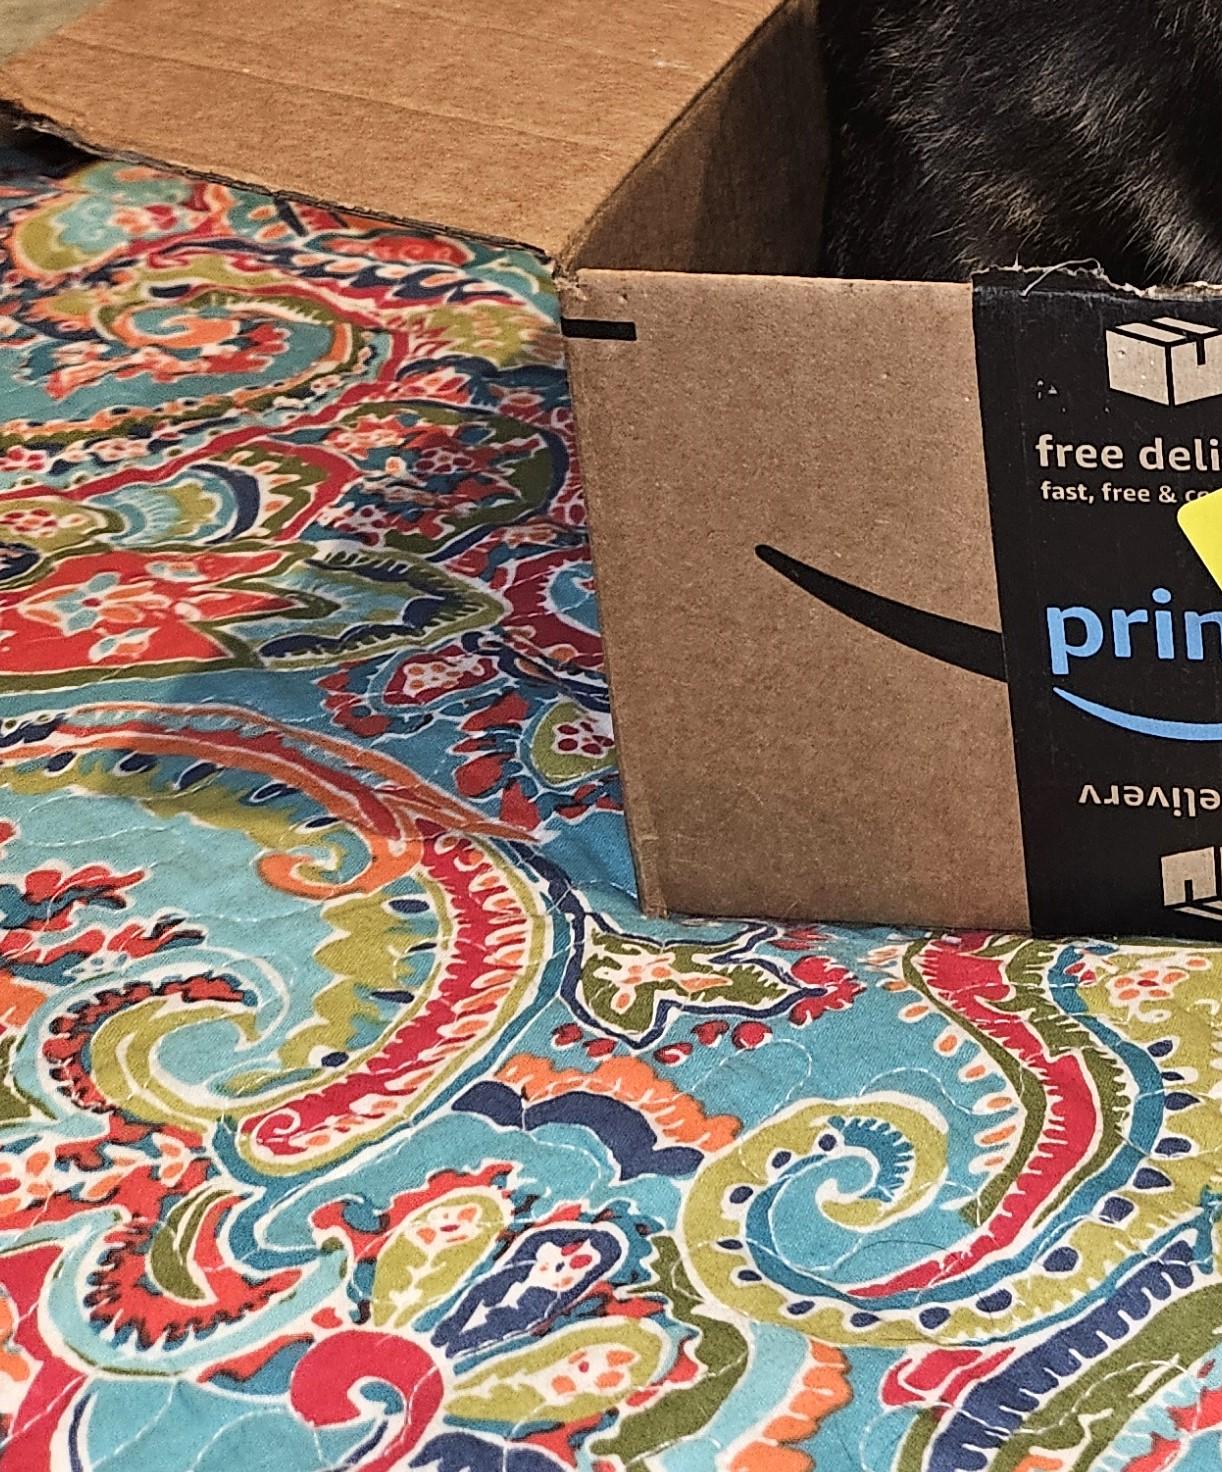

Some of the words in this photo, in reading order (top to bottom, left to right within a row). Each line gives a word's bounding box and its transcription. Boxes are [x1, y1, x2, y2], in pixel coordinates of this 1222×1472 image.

[1035, 434, 1123, 470] free
[1040, 481, 1094, 504] fast,
[1101, 482, 1150, 503] free
[1158, 485, 1178, 504] &
